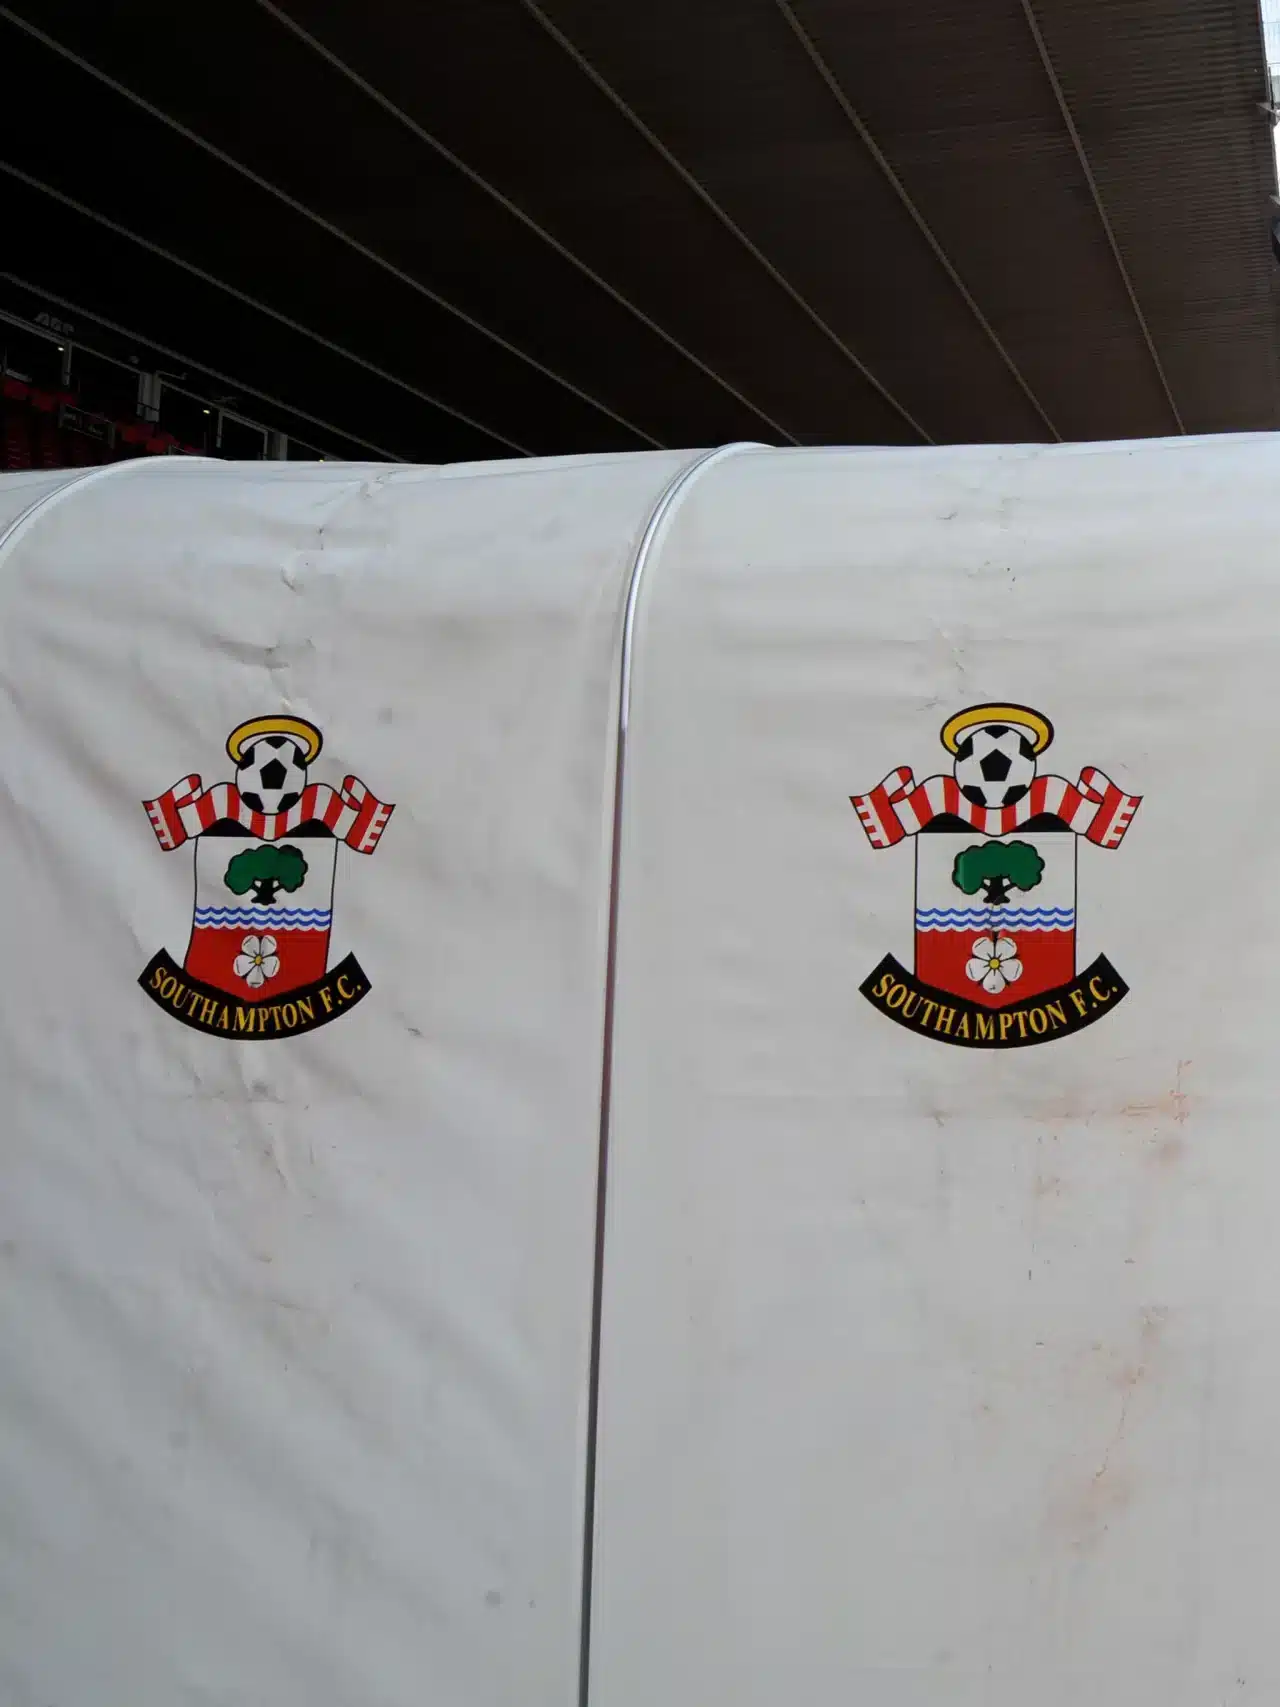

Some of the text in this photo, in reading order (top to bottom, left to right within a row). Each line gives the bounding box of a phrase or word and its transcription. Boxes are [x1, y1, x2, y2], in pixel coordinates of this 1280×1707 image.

[148, 966, 362, 1033] SOUTHAMPTON F.C.
[871, 973, 1119, 1041] SOUTHAMPTON F.C.
